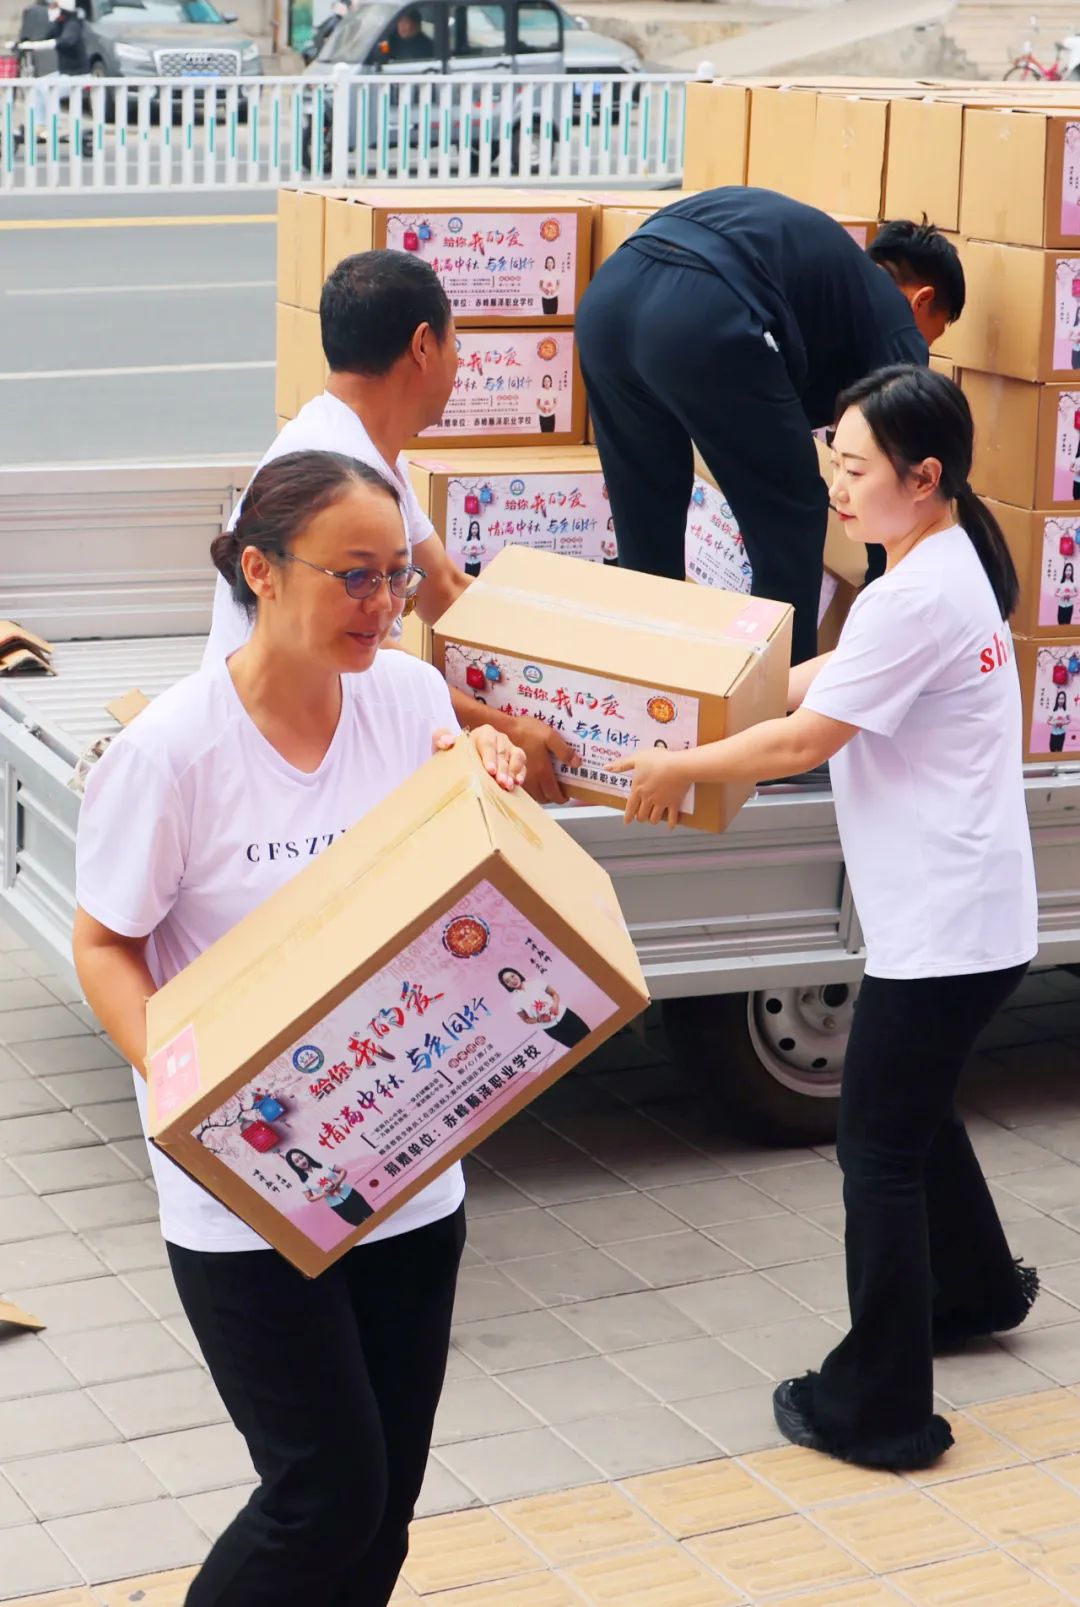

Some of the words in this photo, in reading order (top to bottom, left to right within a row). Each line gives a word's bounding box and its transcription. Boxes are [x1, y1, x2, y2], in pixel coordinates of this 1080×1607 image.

[443, 227, 524, 255] 给你我的爱
[453, 376, 477, 394] 中秋
[505, 488, 587, 517] 给你我的爱
[487, 518, 541, 536] 情满中秋
[547, 518, 598, 534] 与爱同行
[980, 632, 1009, 673] sh
[517, 684, 625, 719] 给你我的爱
[573, 721, 640, 748] 与爱同行
[561, 764, 632, 788] 赤峰顺泽职业学
[246, 829, 346, 863] CFSZZ
[309, 980, 445, 1102] 给你我的爱
[318, 1073, 405, 1150] 情满中秋
[405, 997, 492, 1073] 与爱同行
